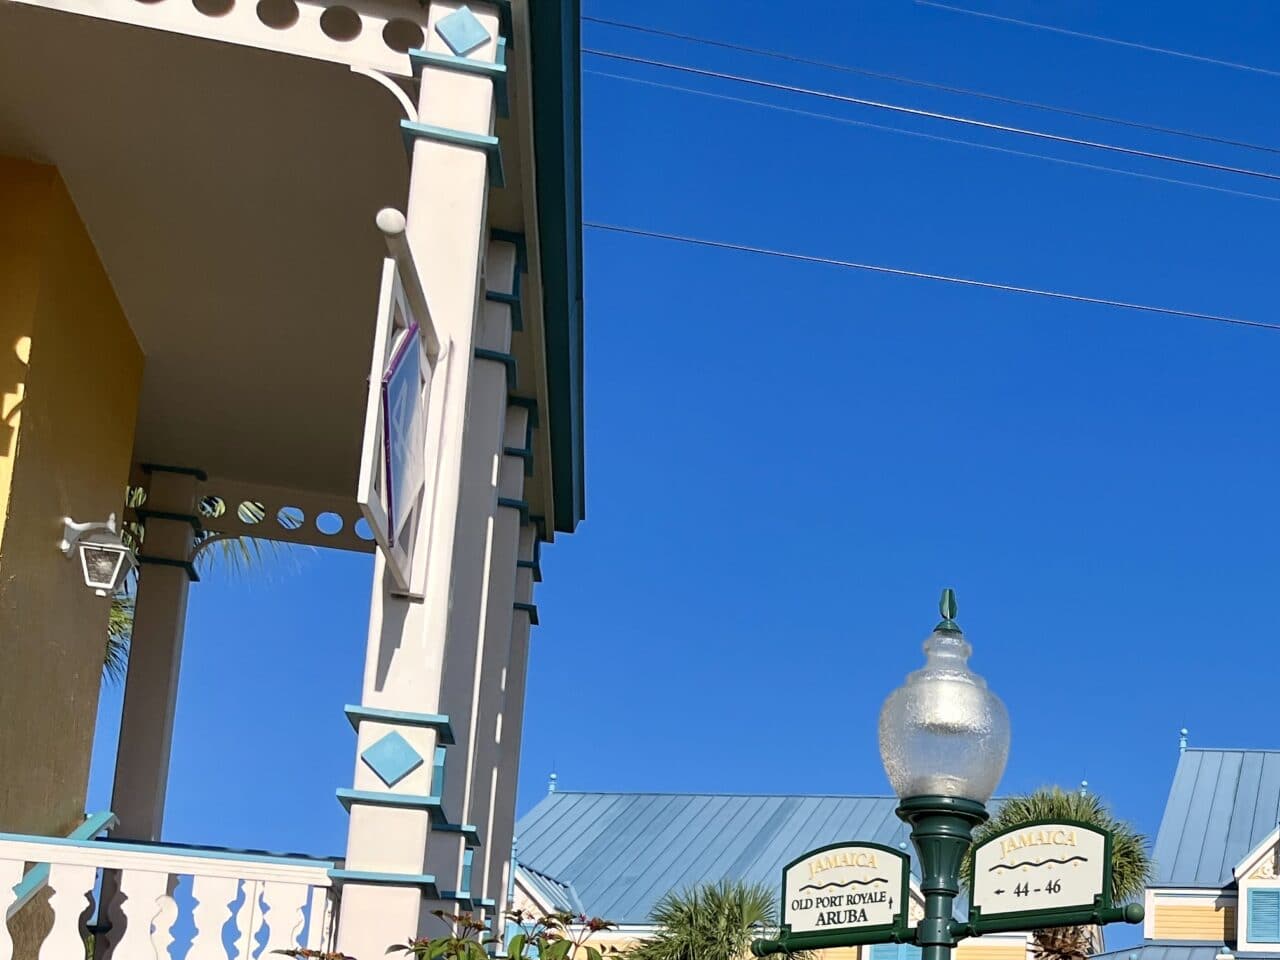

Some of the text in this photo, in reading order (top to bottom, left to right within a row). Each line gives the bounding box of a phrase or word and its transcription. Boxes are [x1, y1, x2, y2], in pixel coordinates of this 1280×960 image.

[999, 830, 1077, 860] JAMAICA
[808, 852, 878, 880] JAMAICA
[1013, 882, 1029, 897] 44
[1045, 879, 1061, 894] 46
[791, 891, 887, 911] OLD PORT ROYALE
[815, 908, 868, 926] ARUBA
